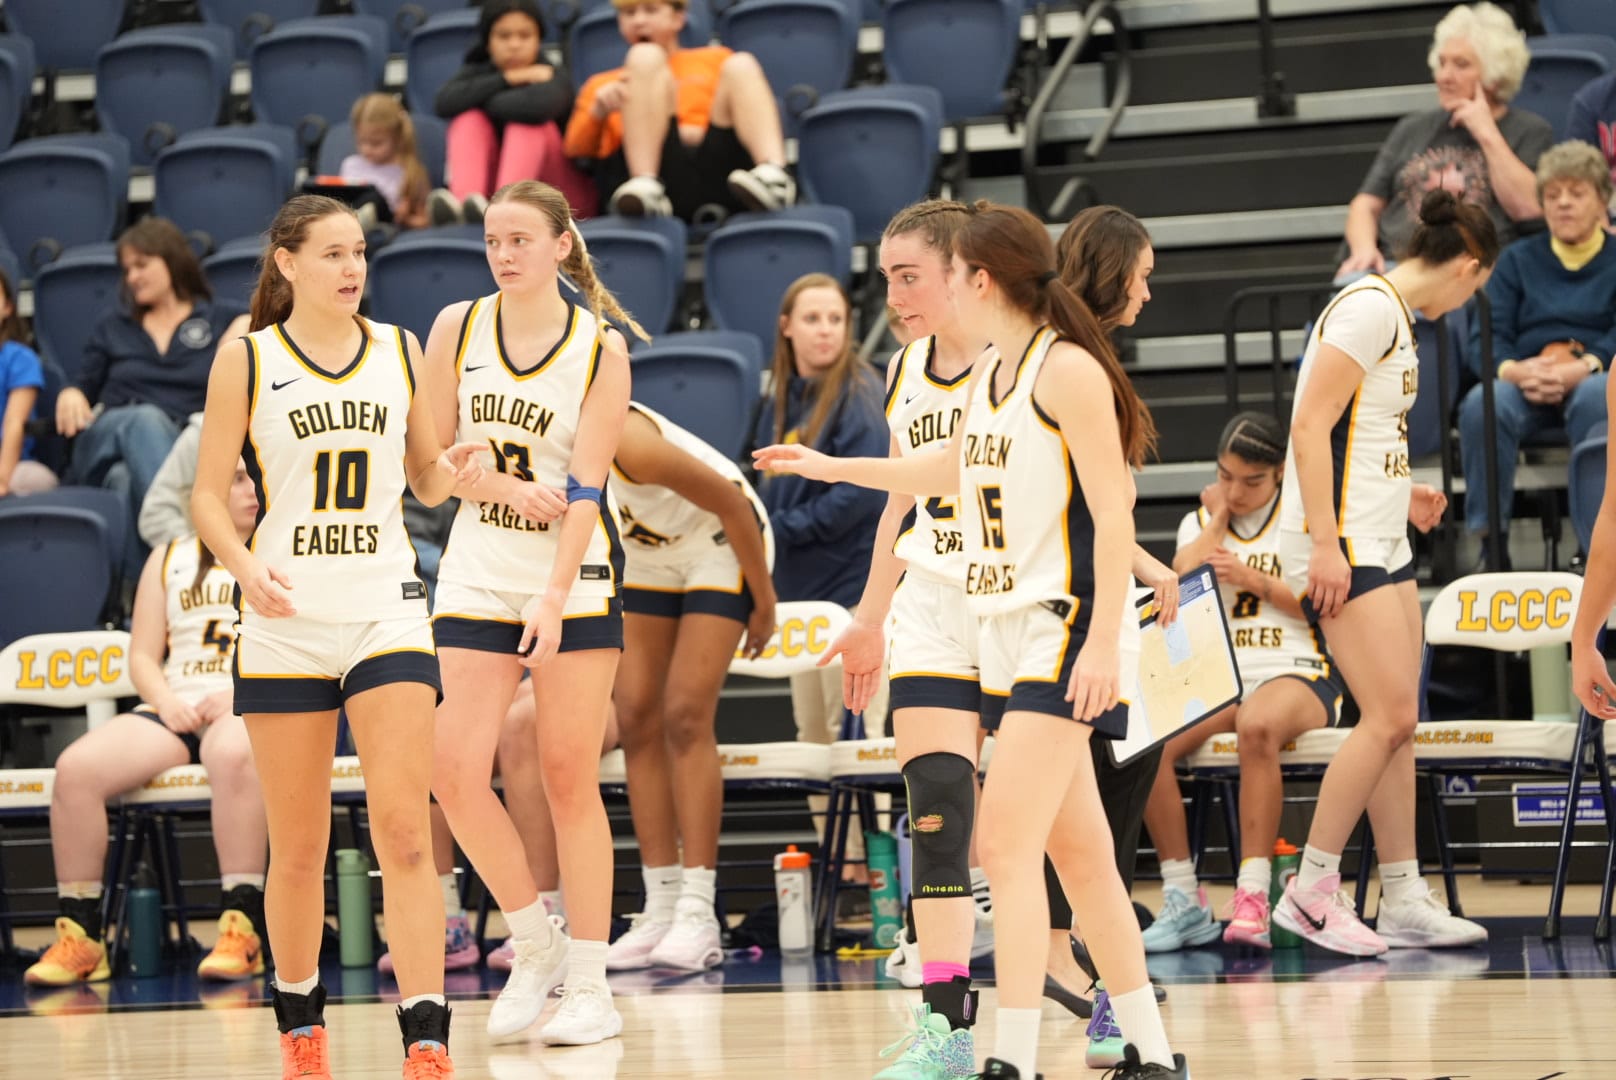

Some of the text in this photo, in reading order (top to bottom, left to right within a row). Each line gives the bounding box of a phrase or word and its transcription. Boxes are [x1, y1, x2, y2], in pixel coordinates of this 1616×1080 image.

[288, 400, 388, 440] GOLDEN
[470, 394, 554, 437] GOLDEN
[908, 408, 963, 449] GOLD
[312, 448, 370, 512] 10
[488, 437, 538, 481] 13
[976, 484, 1007, 551] 15
[293, 524, 379, 556] EAGLES
[180, 583, 233, 611] GOLD
[1455, 587, 1572, 632] LCCC
[202, 619, 233, 656] 4
[757, 615, 830, 659] CC
[15, 645, 124, 690] LCCC
[1414, 729, 1494, 744] oLCCC.COM
